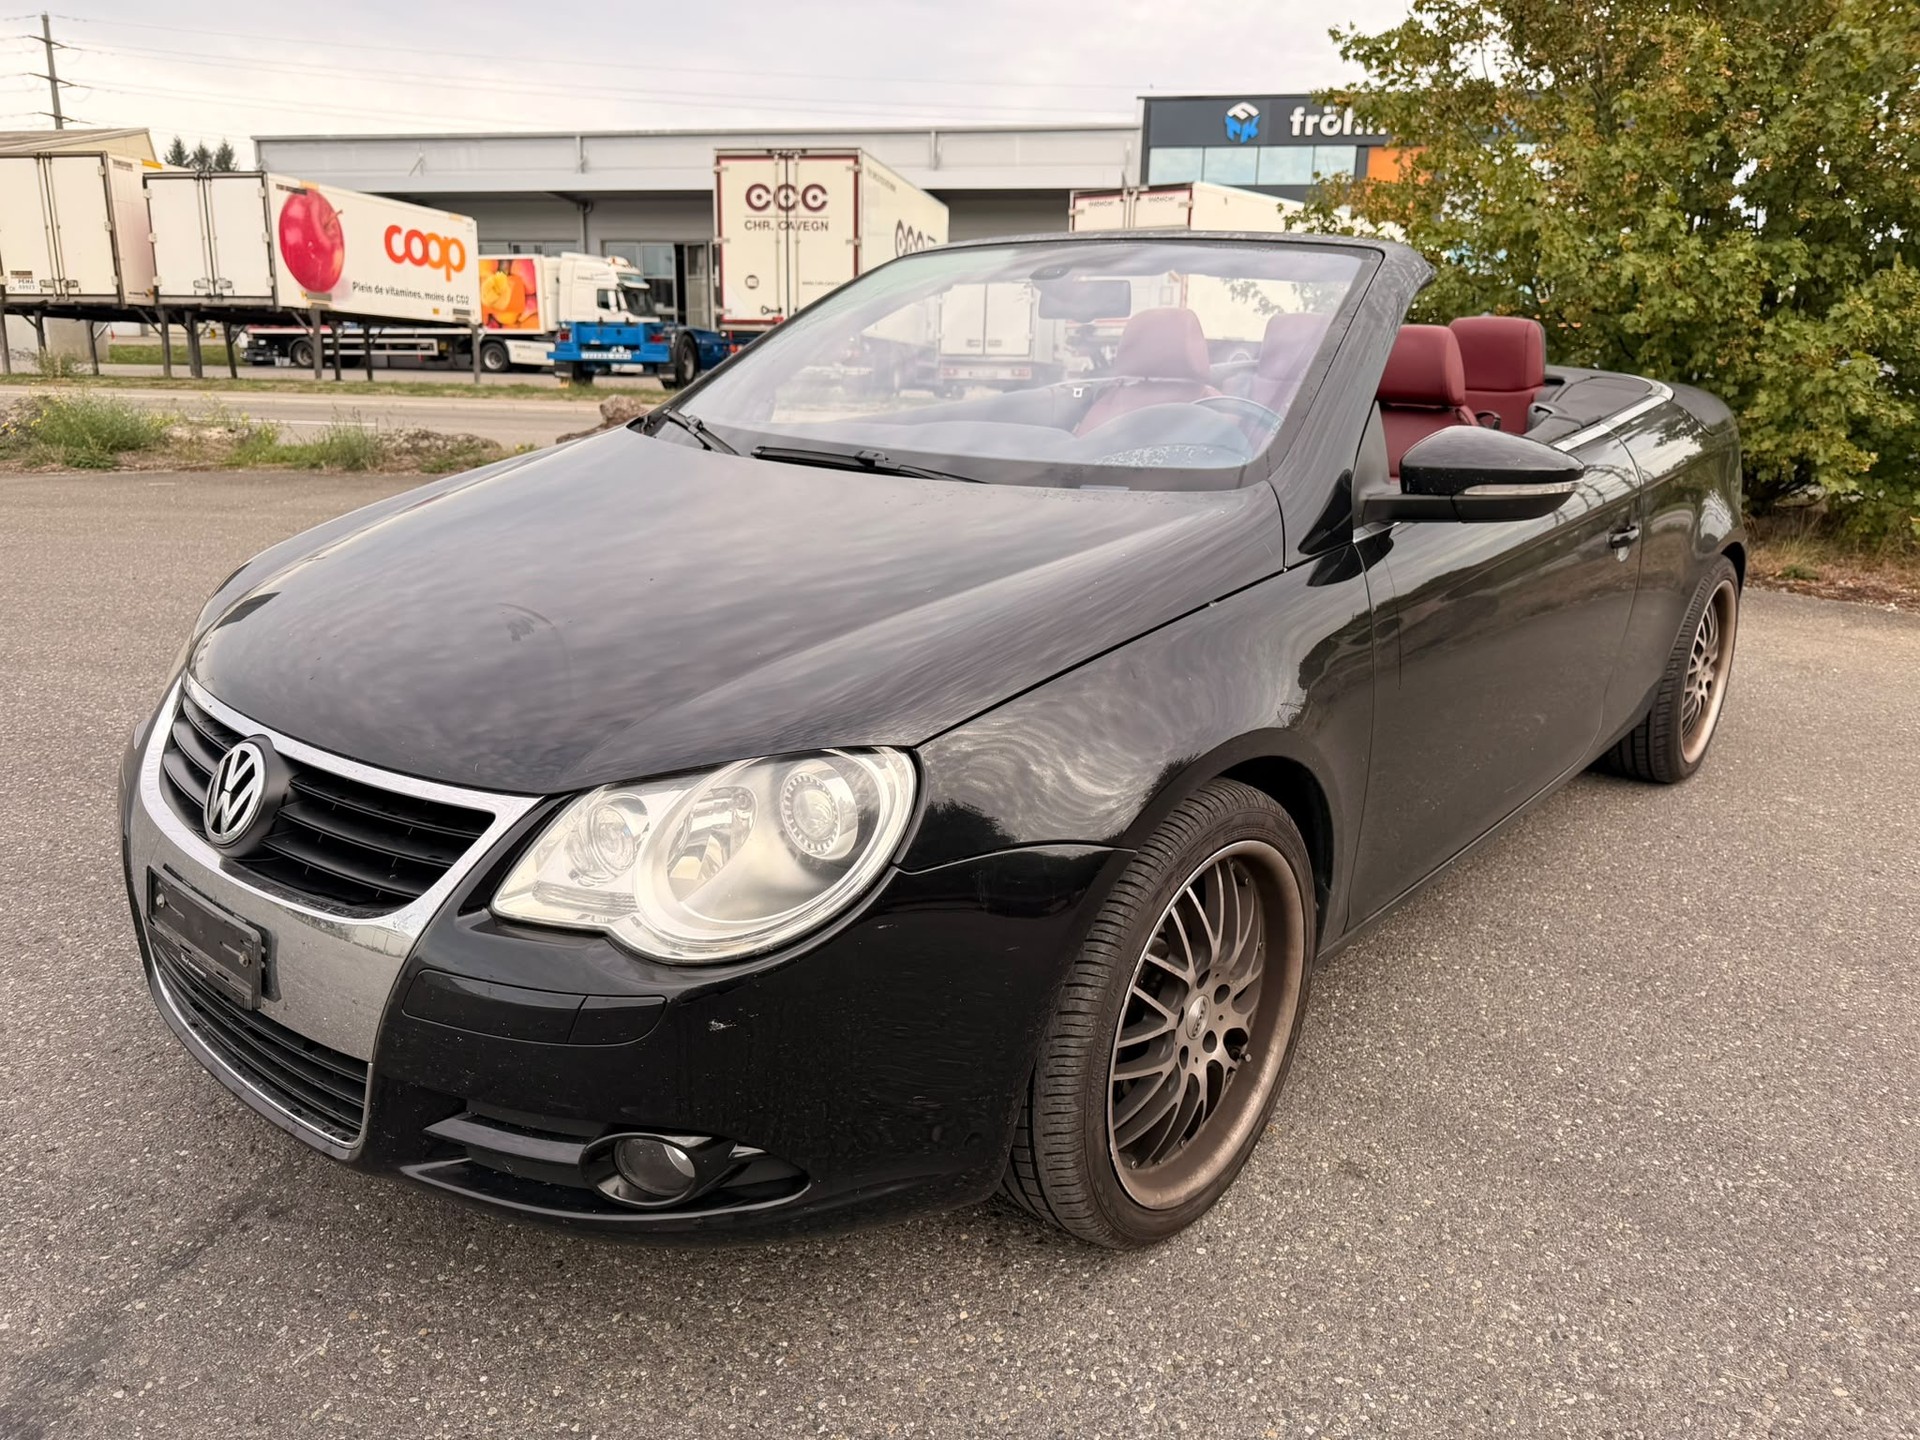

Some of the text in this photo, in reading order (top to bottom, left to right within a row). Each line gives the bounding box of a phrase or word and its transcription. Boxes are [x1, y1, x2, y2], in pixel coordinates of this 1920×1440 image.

[744, 220, 829, 231] CHR. CAVEGN
[384, 225, 466, 282] coop
[352, 281, 373, 293] Plein
[374, 285, 383, 295] de
[424, 291, 445, 302] moins
[455, 294, 470, 305] CO2
